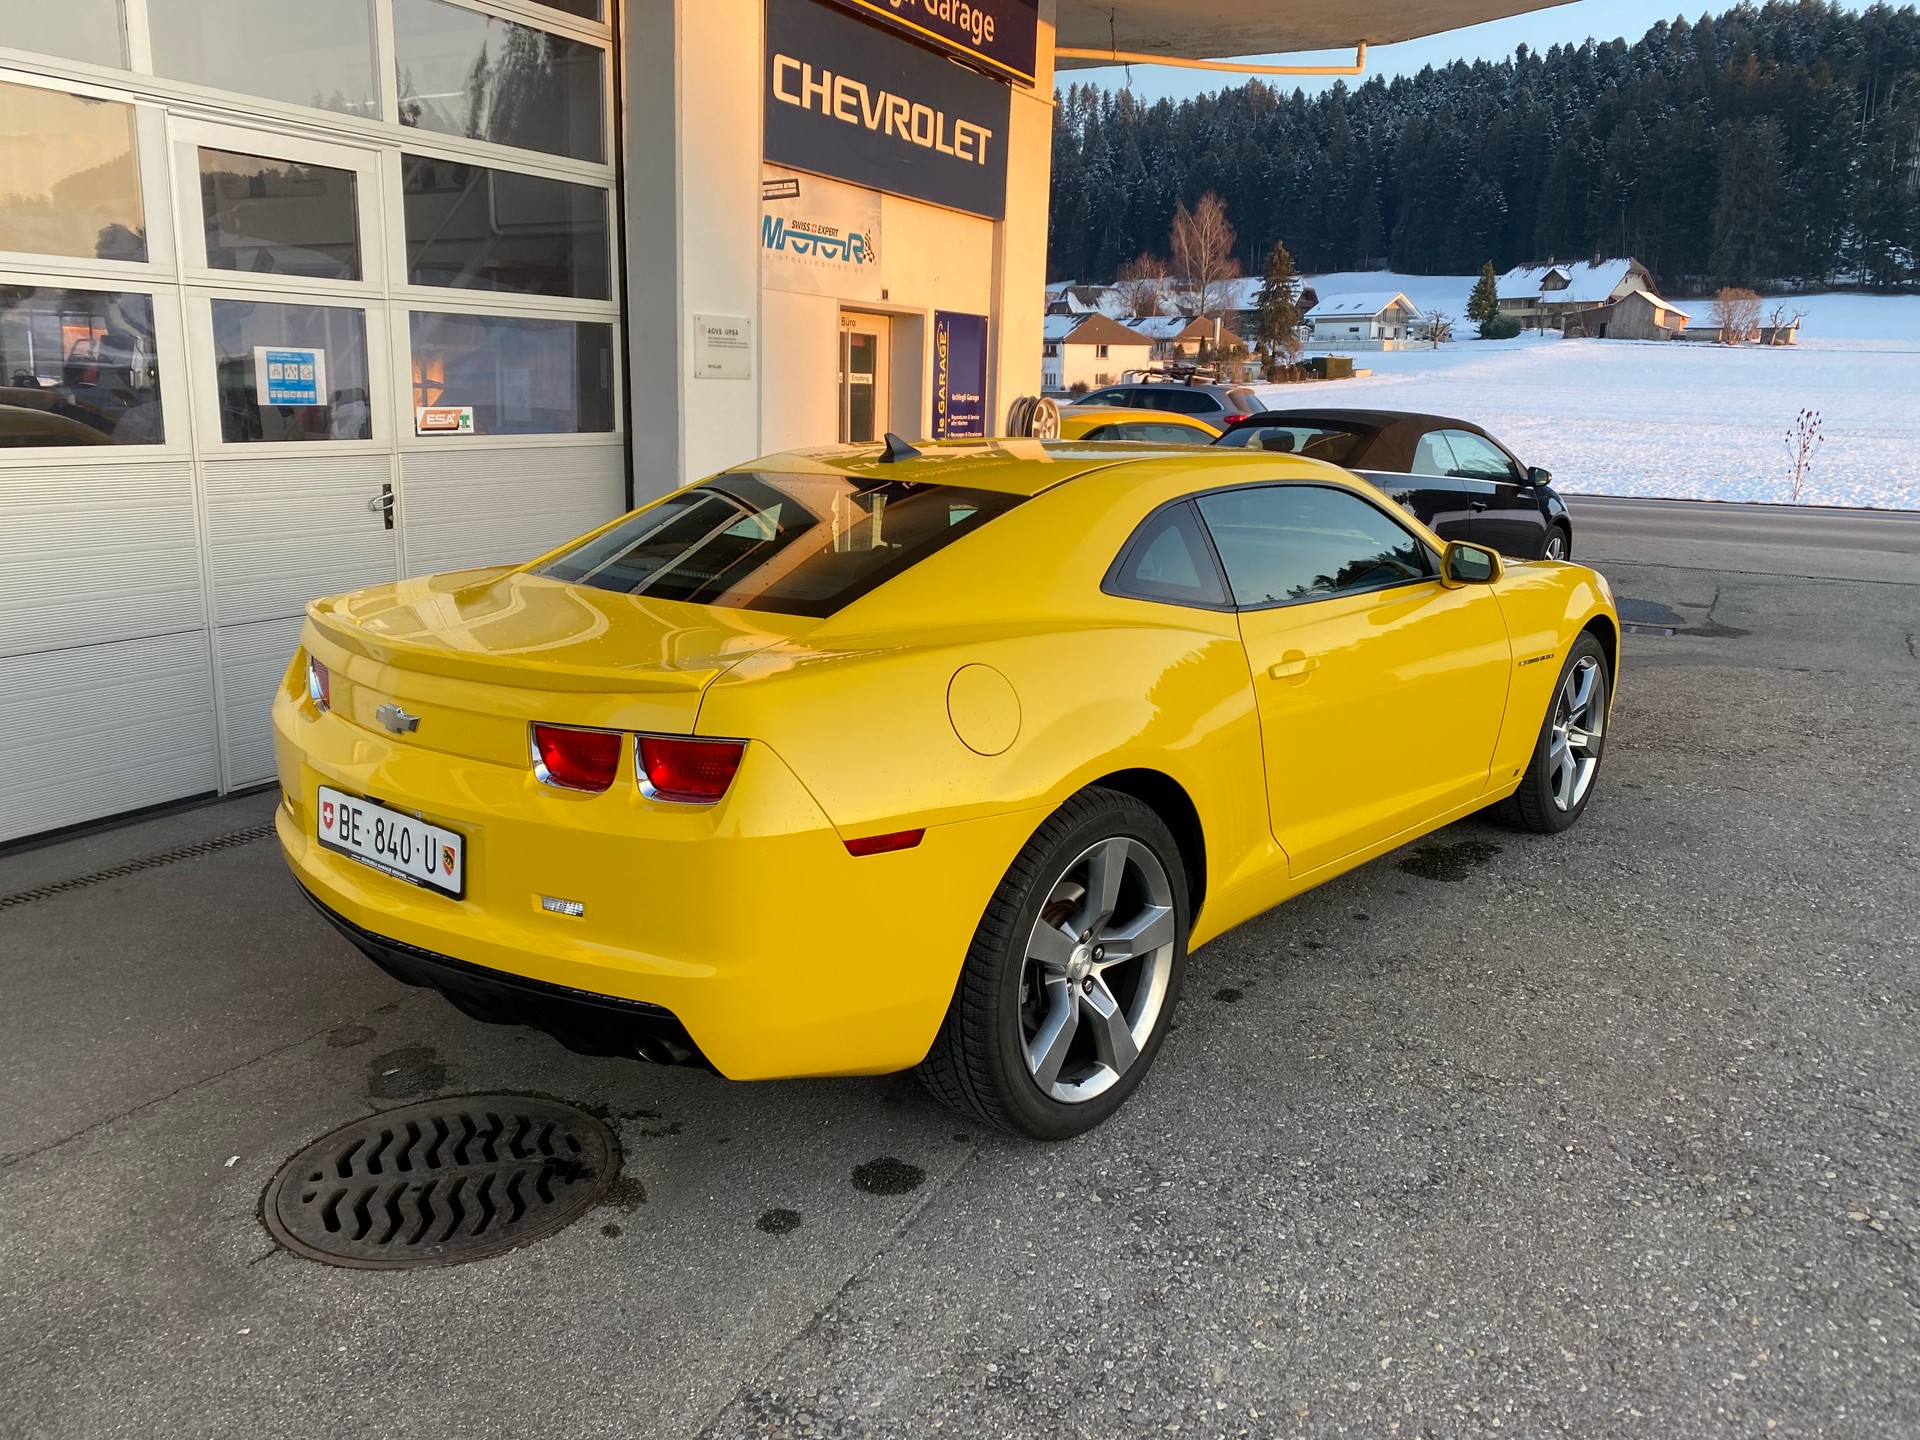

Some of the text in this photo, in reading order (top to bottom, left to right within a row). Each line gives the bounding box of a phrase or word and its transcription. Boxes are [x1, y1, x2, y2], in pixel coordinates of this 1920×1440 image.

[772, 53, 993, 166] CHEVROLET
[791, 219, 840, 238] SWISS EXPERT
[841, 316, 856, 327] Büro
[851, 374, 870, 383] Empfang
[938, 331, 947, 414] GARAGE
